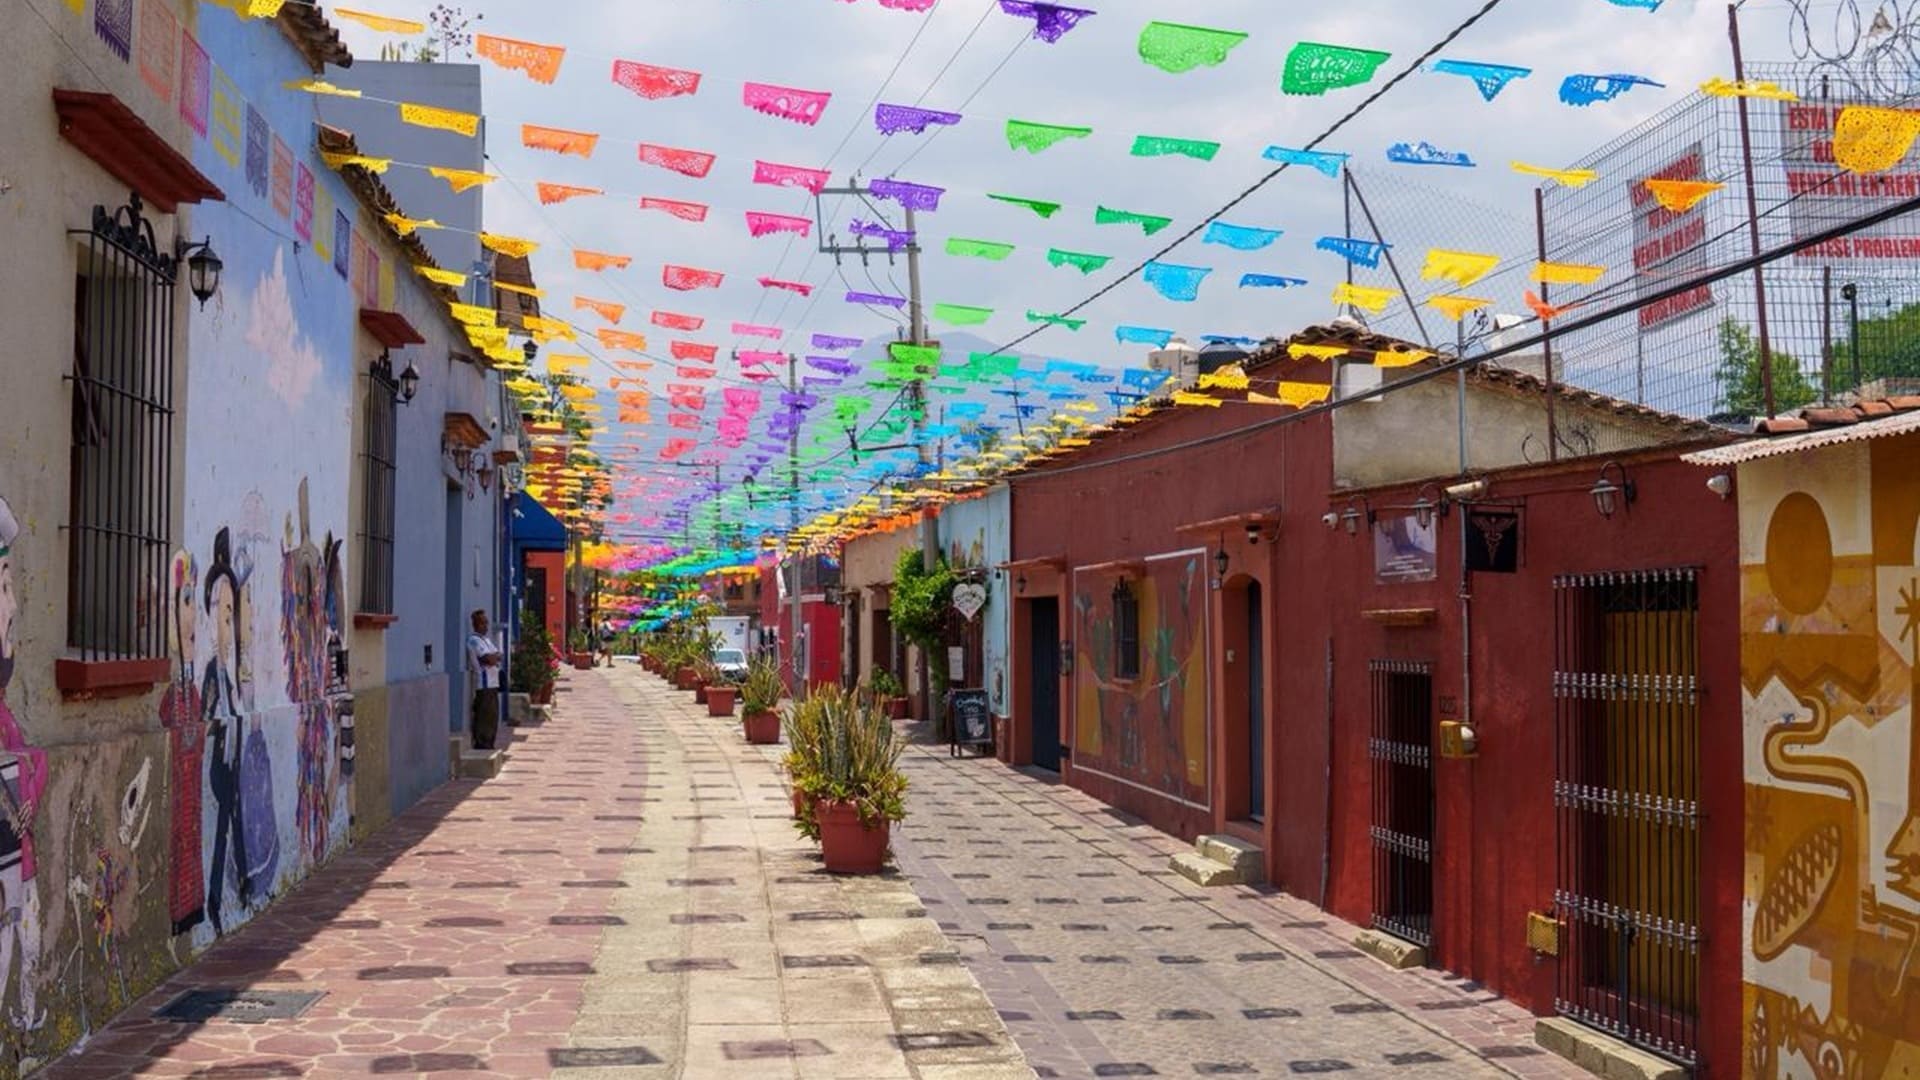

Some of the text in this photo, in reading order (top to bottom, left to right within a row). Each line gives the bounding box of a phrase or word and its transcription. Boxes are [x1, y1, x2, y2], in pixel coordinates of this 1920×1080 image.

[1790, 106, 1827, 130] ESTA
[1787, 171, 1838, 196] VENTA
[1839, 173, 1856, 196] NI
[1860, 174, 1880, 197] EN
